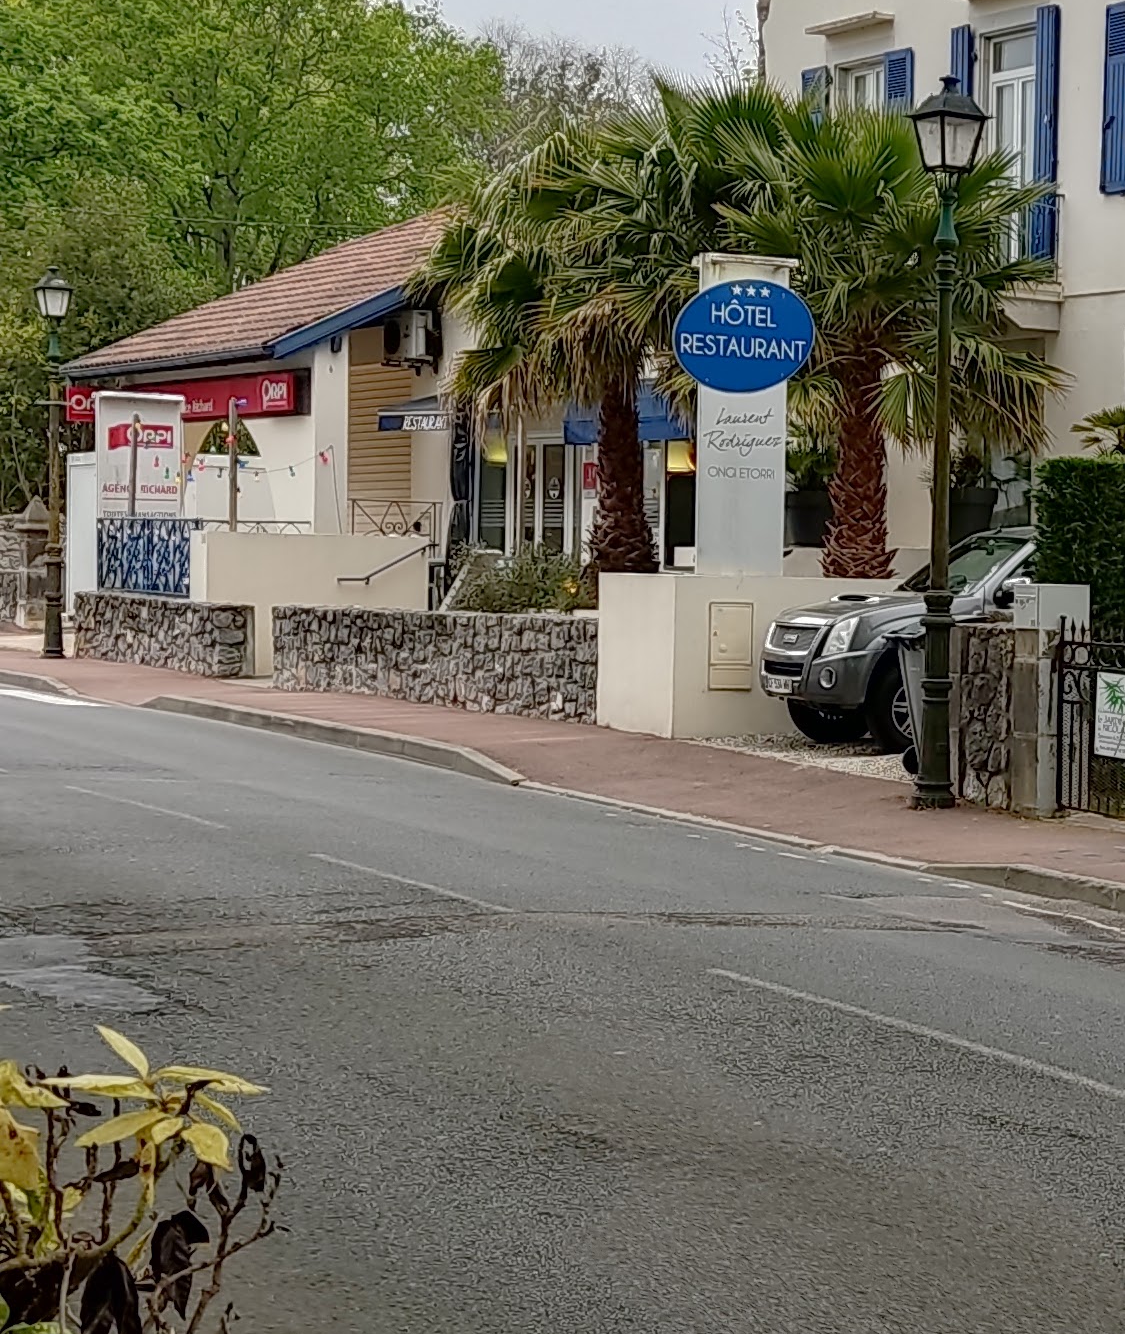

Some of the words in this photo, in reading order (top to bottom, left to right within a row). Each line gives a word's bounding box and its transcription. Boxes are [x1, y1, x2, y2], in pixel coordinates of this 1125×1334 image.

[711, 299, 777, 328] HÔTEL
[680, 333, 806, 362] RESTAURANT
[715, 407, 775, 425] Laurent
[703, 430, 783, 457] Rodriguez
[739, 467, 775, 480] ETORRI
